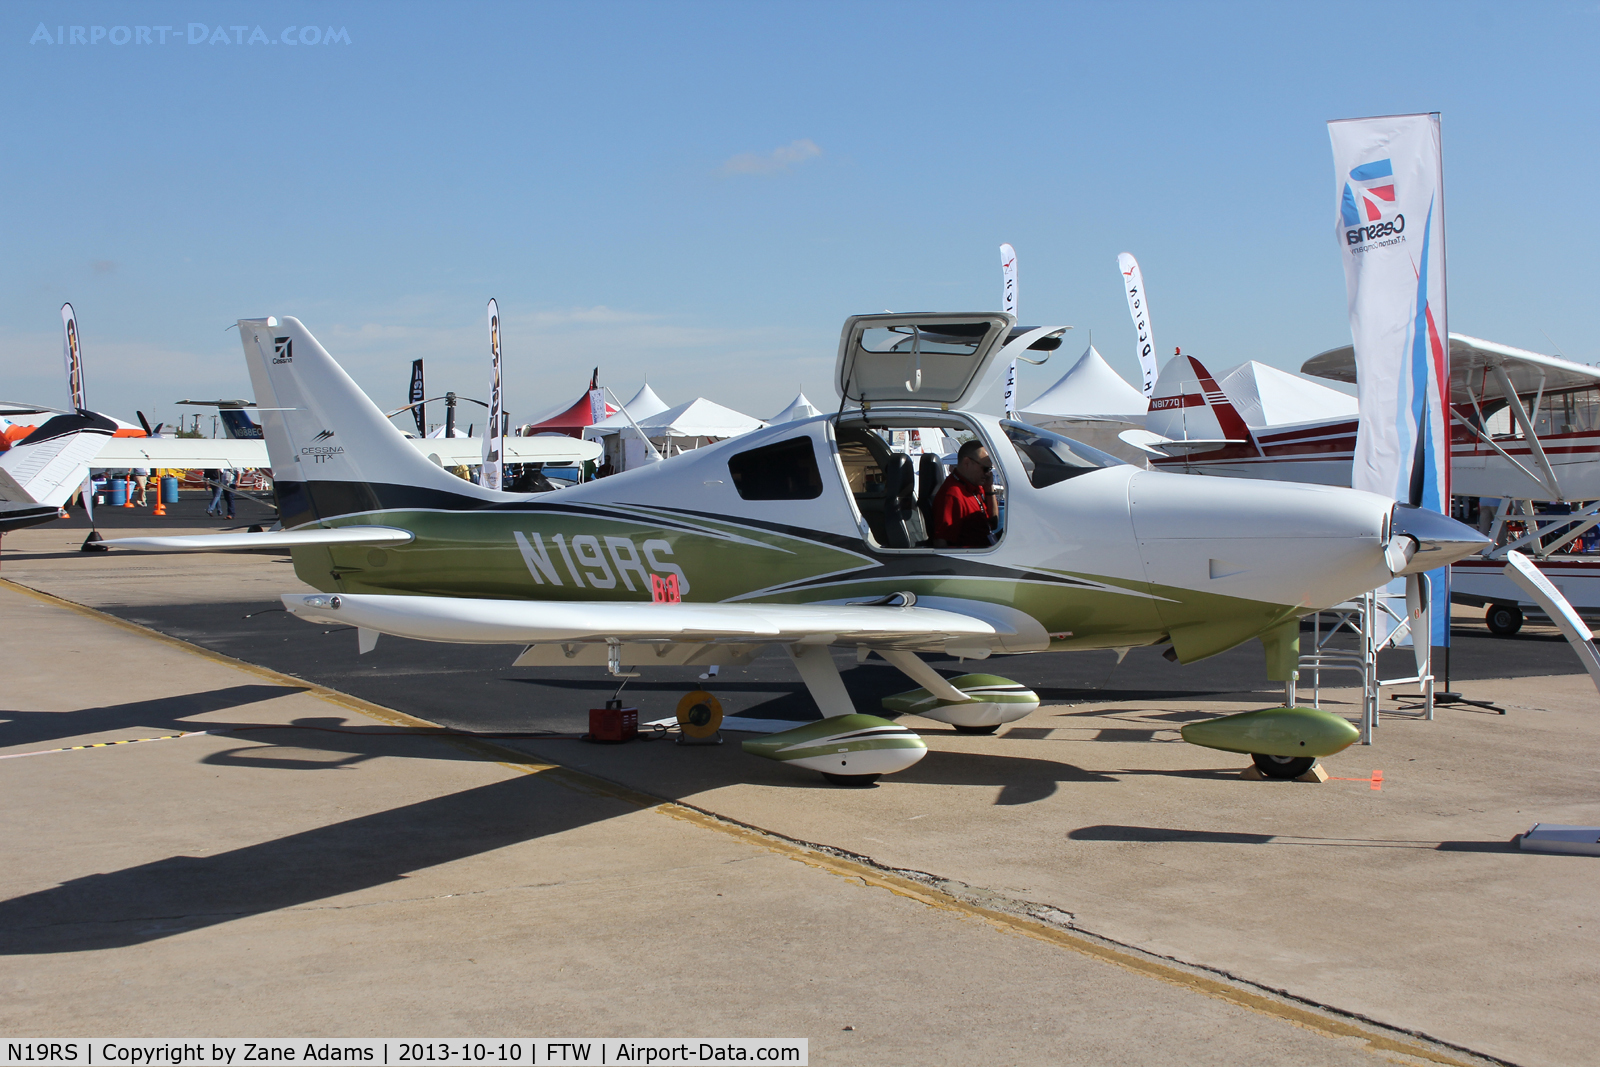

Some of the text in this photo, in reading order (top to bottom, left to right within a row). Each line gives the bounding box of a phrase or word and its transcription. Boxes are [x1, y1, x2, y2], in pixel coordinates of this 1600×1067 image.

[272, 357, 293, 365] Cessna
[1152, 398, 1180, 409] N8177D
[301, 446, 345, 455] CESSNA
[513, 530, 690, 595] N19RS
